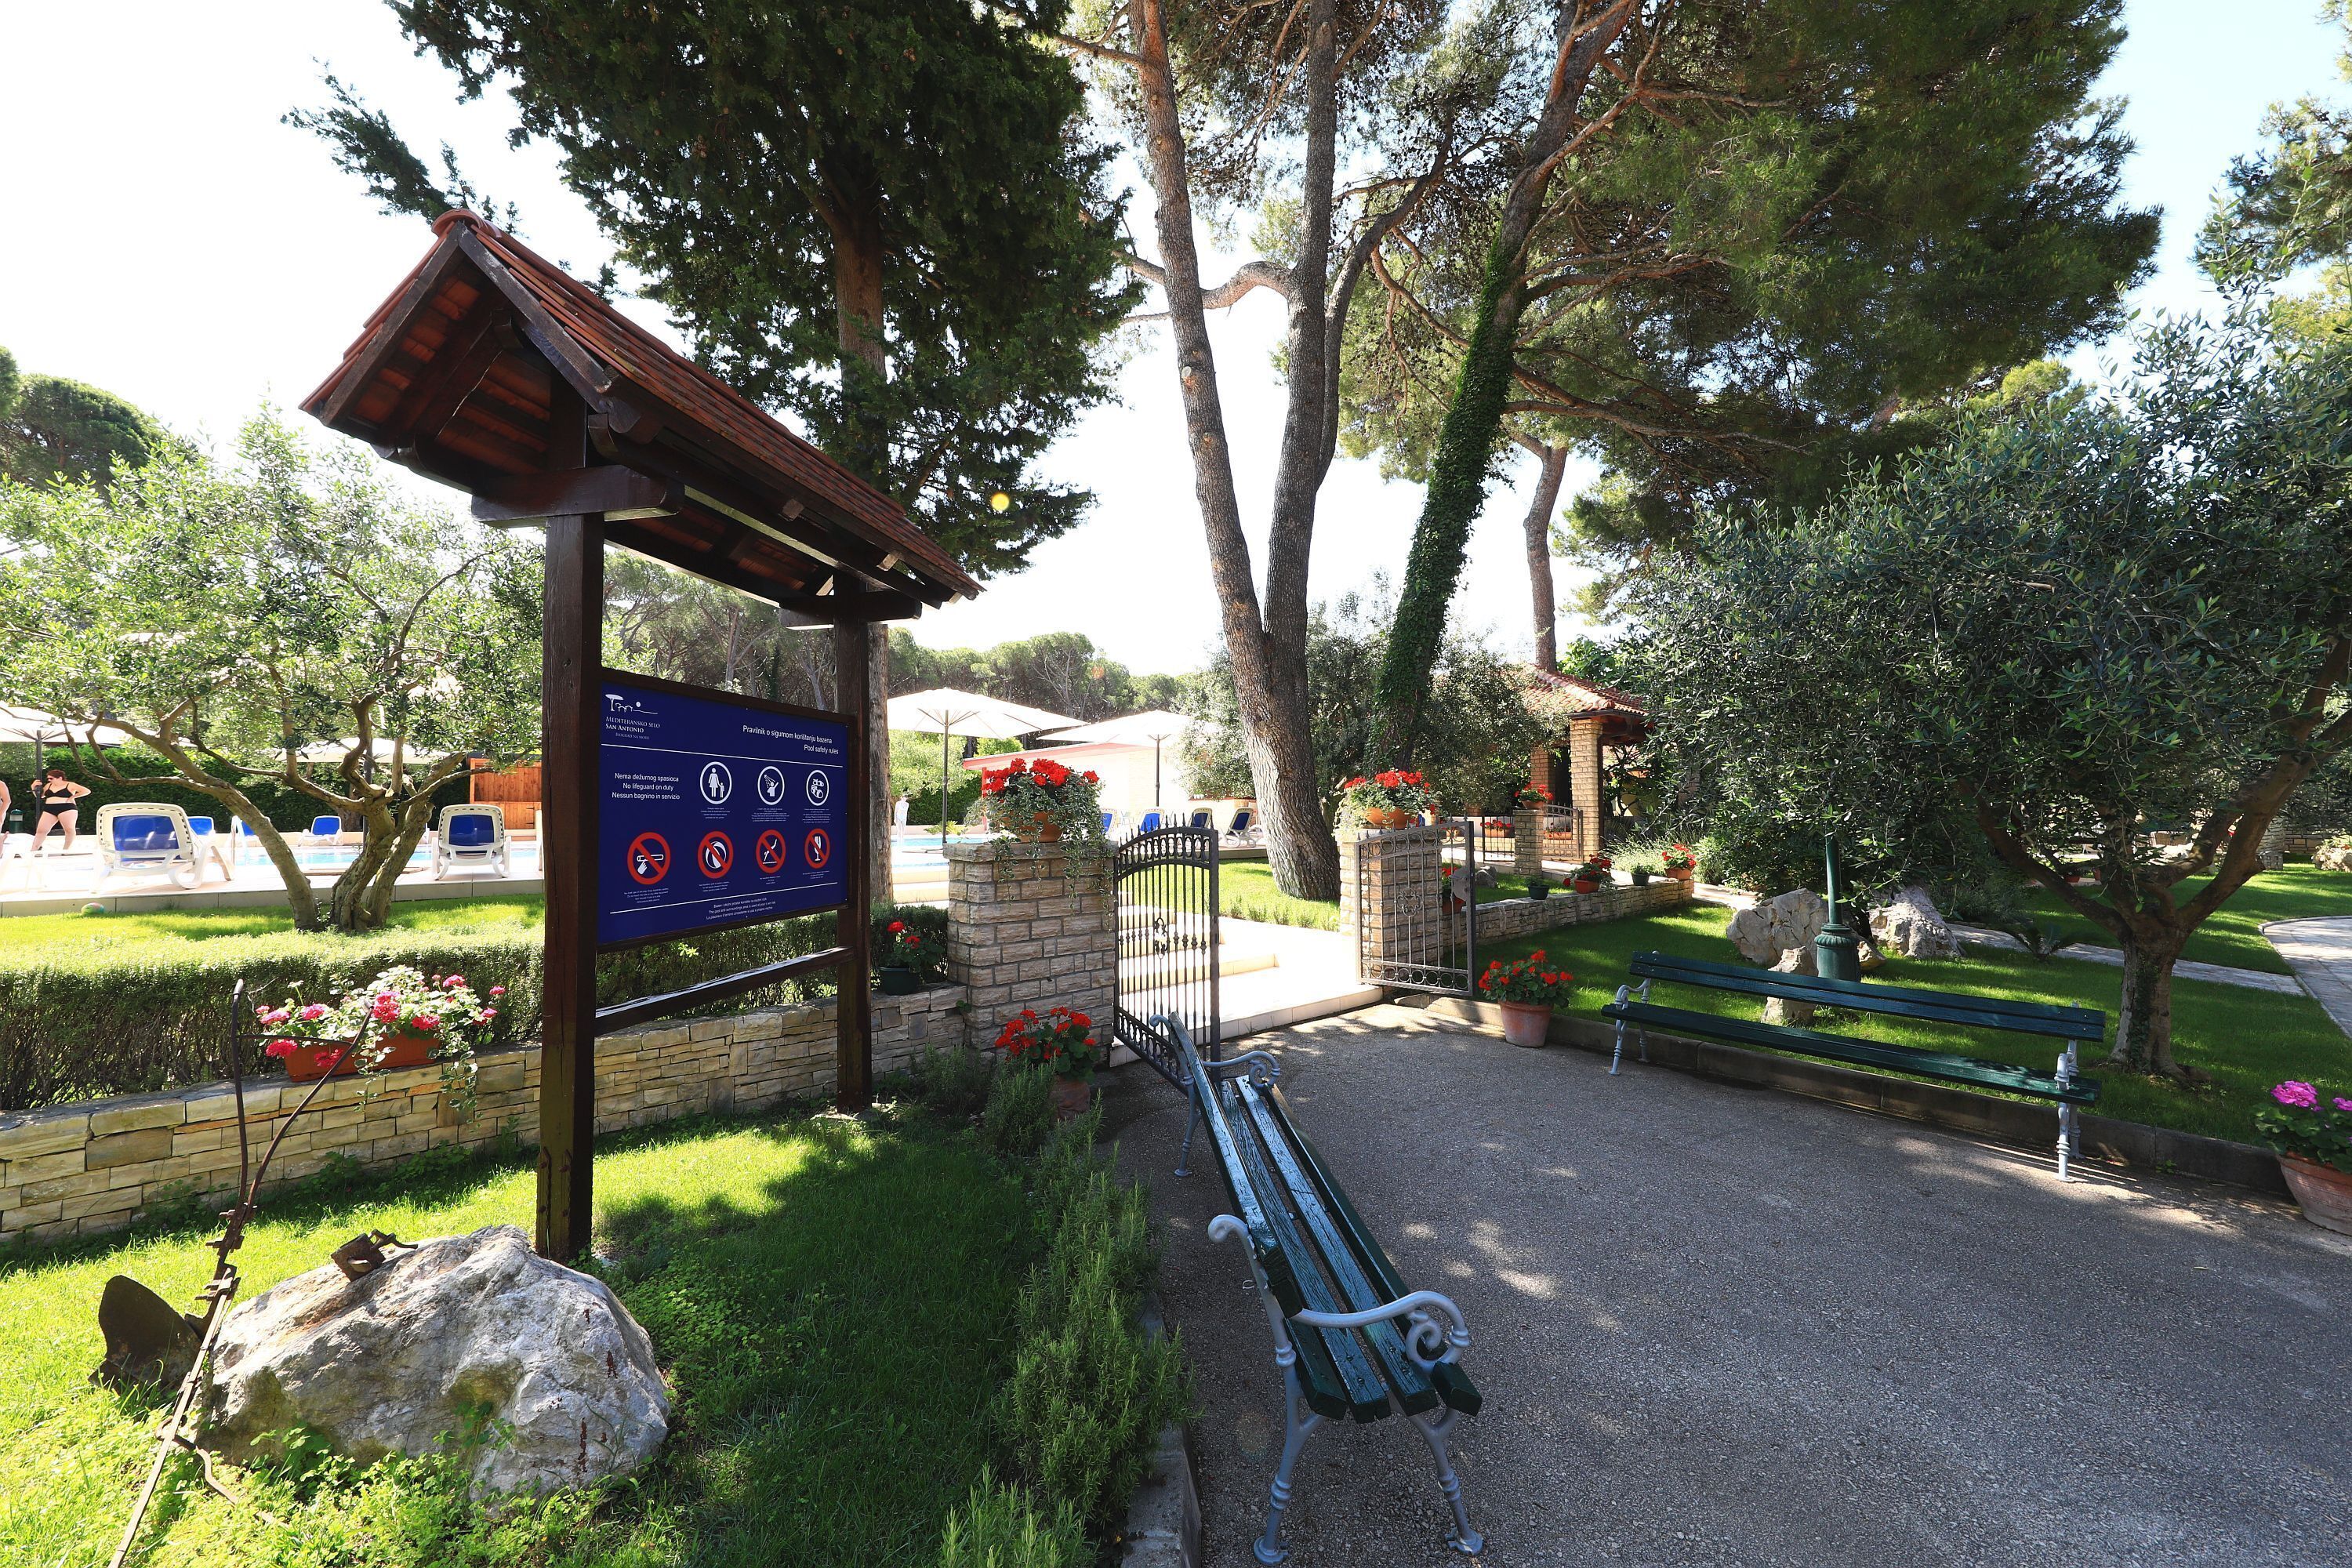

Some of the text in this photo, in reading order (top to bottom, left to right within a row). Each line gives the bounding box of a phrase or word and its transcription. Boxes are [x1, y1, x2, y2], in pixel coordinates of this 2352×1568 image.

[606, 716, 648, 726] MEDITERANSKO
[743, 725, 765, 735] Pravilnik
[794, 733, 816, 743] korištenju
[815, 746, 828, 754] safety
[632, 774, 657, 782] dežurnog
